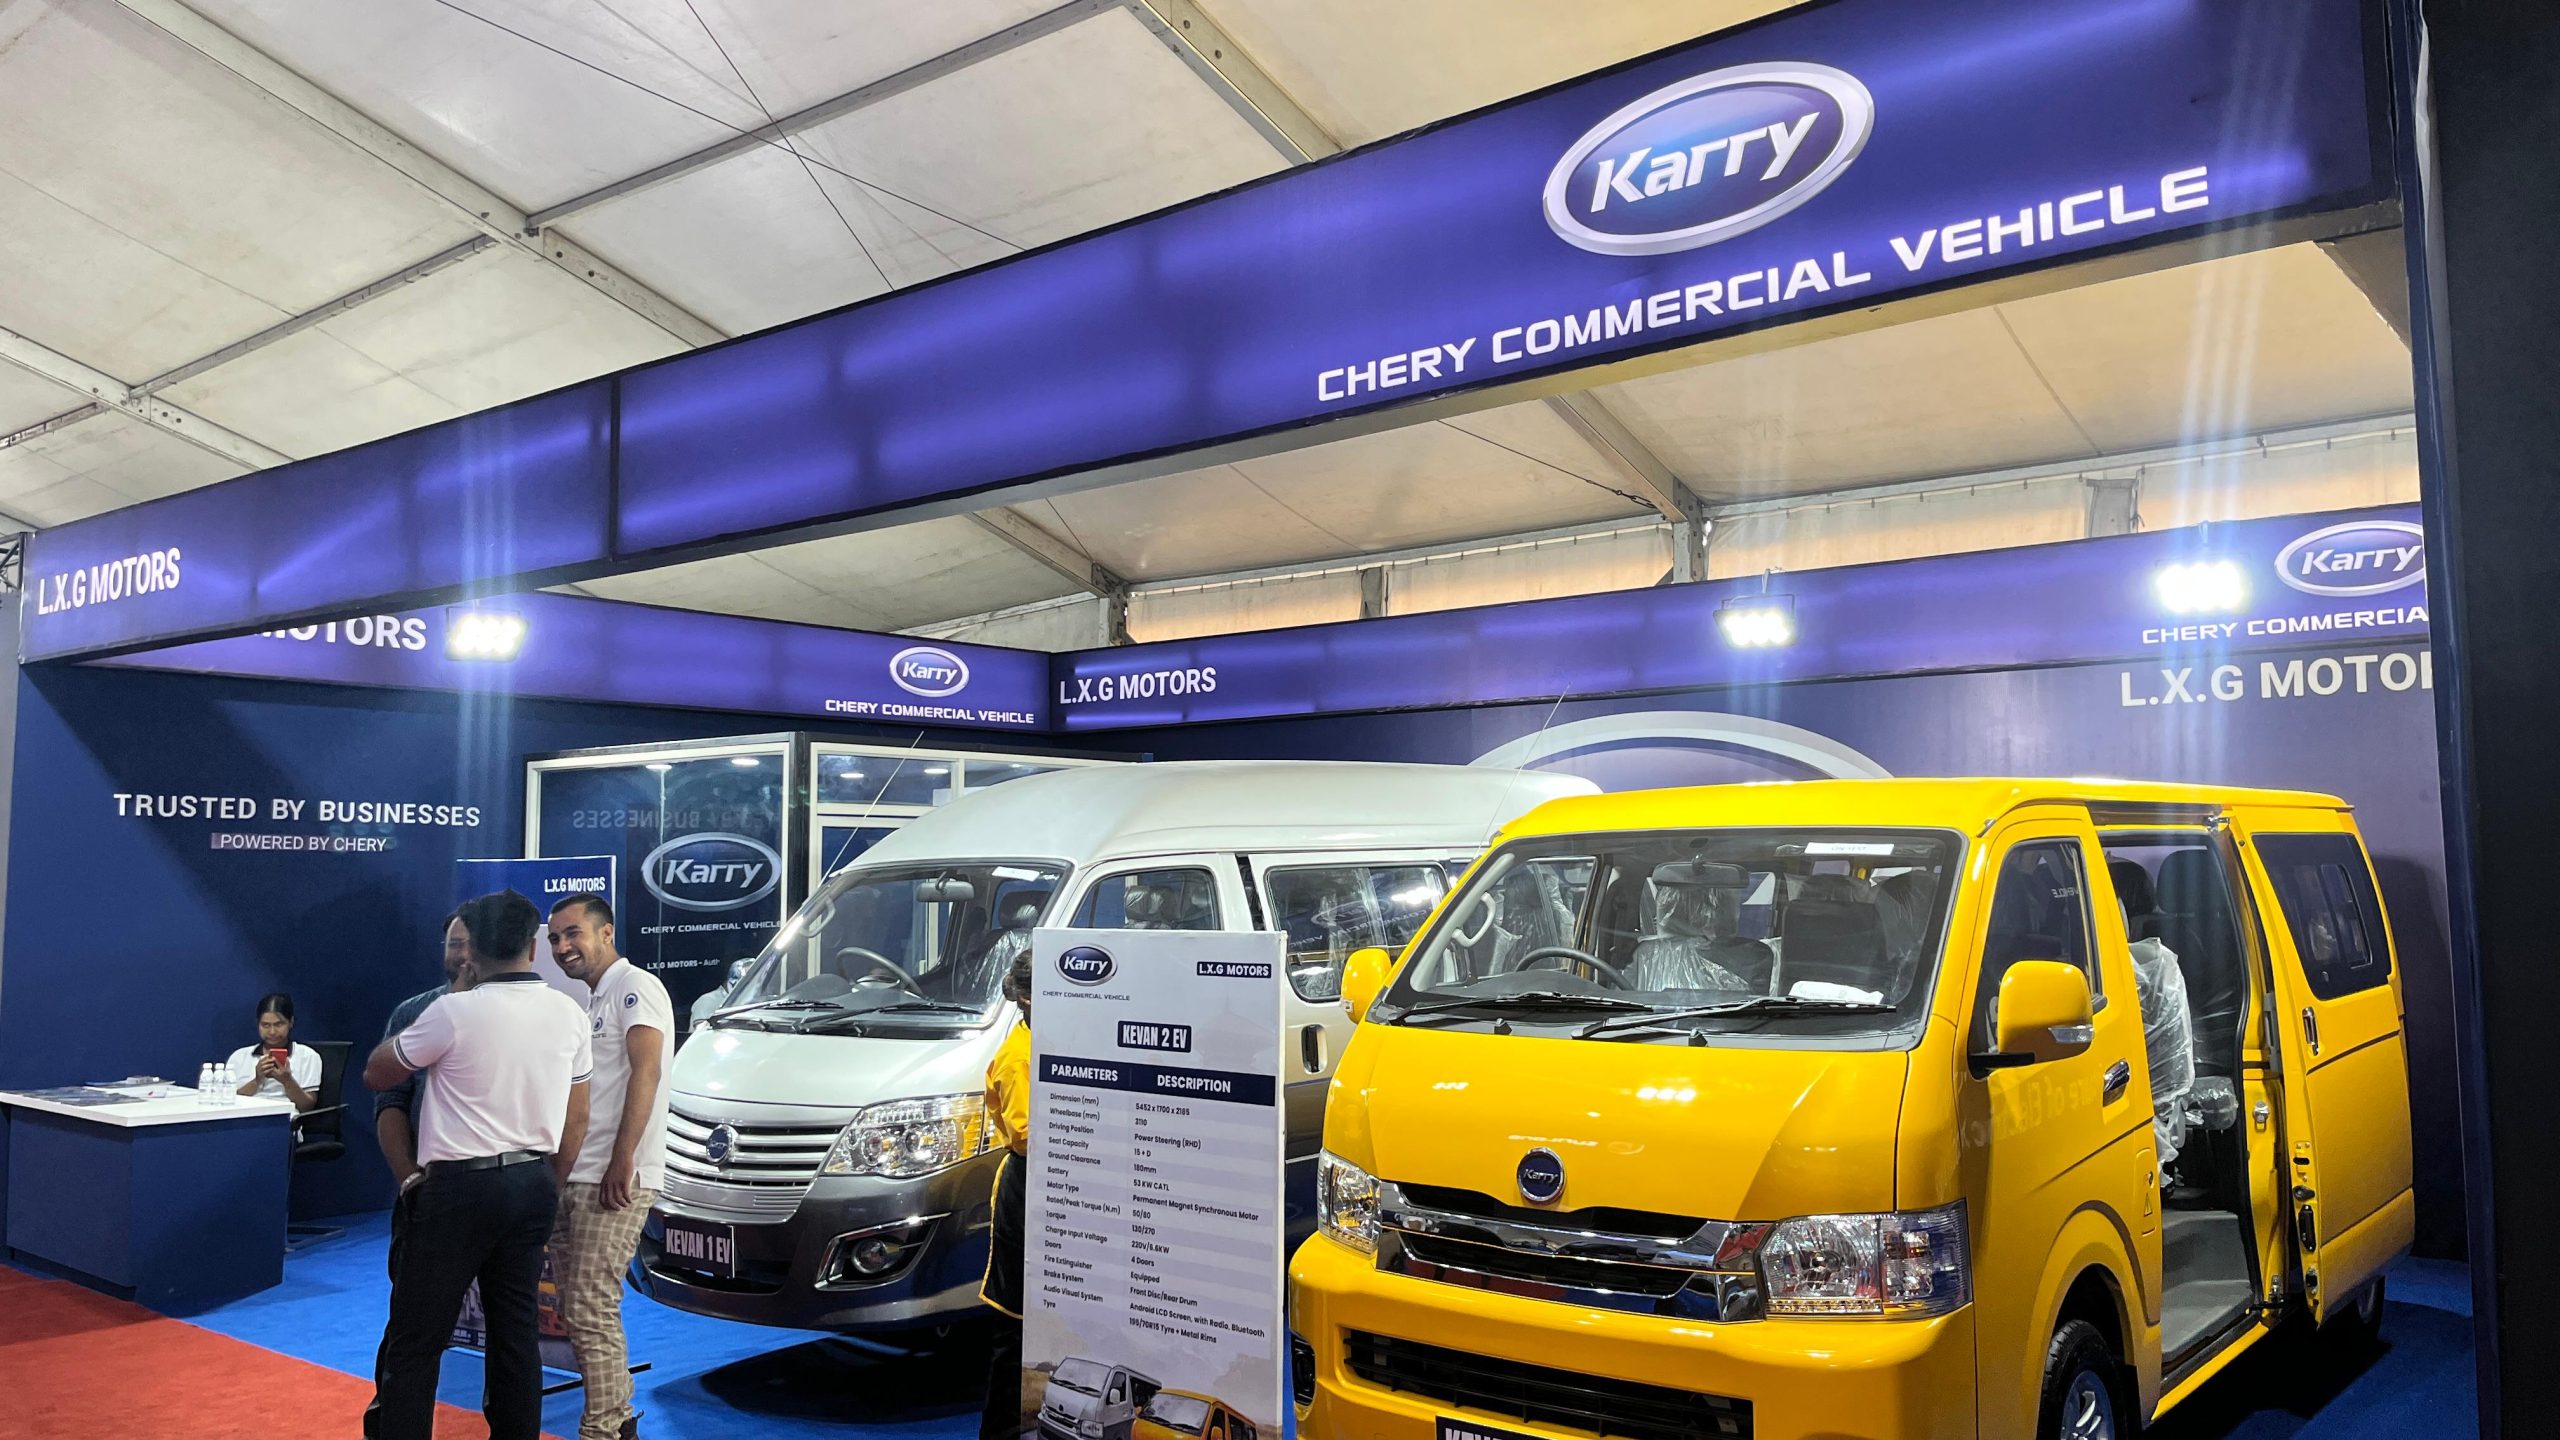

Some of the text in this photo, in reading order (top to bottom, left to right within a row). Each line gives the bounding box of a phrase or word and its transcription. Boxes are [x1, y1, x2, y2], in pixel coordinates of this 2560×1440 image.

[1590, 111, 1820, 213] Karry
[1318, 166, 2209, 401] CHERY COMMERCIAL VEHICLE
[2301, 545, 2421, 575] Karry
[38, 547, 180, 615] L.X.G MOTORS
[2143, 622, 2238, 643] CHERY
[903, 662, 958, 685] Karry
[1060, 667, 1216, 704] L.X.G MOTORS
[2121, 664, 2244, 707] L.X.G
[825, 700, 1034, 724] CHERY COMMERCIAL VEHICLE
[113, 793, 480, 827] TRUSTED BY BUSINESSES
[220, 834, 387, 852] POWERED BY CHERY
[664, 859, 763, 888] Karry
[568, 876, 605, 892] MOTORS
[641, 926, 675, 934] CHERY
[678, 922, 741, 933] COMMERCIAL
[667, 960, 698, 968] MOTORS
[1064, 956, 1108, 975] Karry
[1199, 964, 1269, 976] L.X.G MOTORS
[1064, 992, 1102, 1000] COMMERCIAL
[1122, 1024, 1187, 1049] KEVAN 2 EV
[1051, 1064, 1231, 1093] PARAMETERS DESCRIPTION
[1049, 1122, 1094, 1134] Driving Position
[1062, 1139, 1089, 1150] Capacity
[1155, 1136, 1181, 1148] Steering
[1048, 1151, 1100, 1164] Ground Clearance
[1048, 1166, 1069, 1177] Battery
[1524, 1168, 1558, 1183] Karry
[1047, 1181, 1079, 1193] Motor Type
[1046, 1210, 1066, 1220] Torque
[1081, 1201, 1102, 1211] Torque
[1132, 1194, 1259, 1221] Permanent Magnet Synchronous Motor
[1045, 1225, 1066, 1237] Charge
[1084, 1232, 1108, 1244] Voltage
[666, 1228, 730, 1264] KEVAN 1 EV
[1045, 1240, 1061, 1249] Doors
[1044, 1254, 1092, 1269] Fire Extinguisher
[1136, 1257, 1154, 1266] Doors
[1062, 1272, 1084, 1283] System
[1130, 1272, 1160, 1284] Equipped
[1044, 1284, 1103, 1302] Audio Visual System
[1130, 1287, 1146, 1296] Front
[1180, 1296, 1198, 1306] Drum
[1043, 1299, 1056, 1308] Tyre
[1130, 1302, 1154, 1314] Android
[1156, 1308, 1168, 1317] LCD
[1194, 1316, 1208, 1326] with
[1231, 1324, 1265, 1338] Bluetooth
[1160, 1324, 1174, 1335] Tyre
[1180, 1328, 1199, 1339] Metal
[1200, 1332, 1216, 1343] Rims
